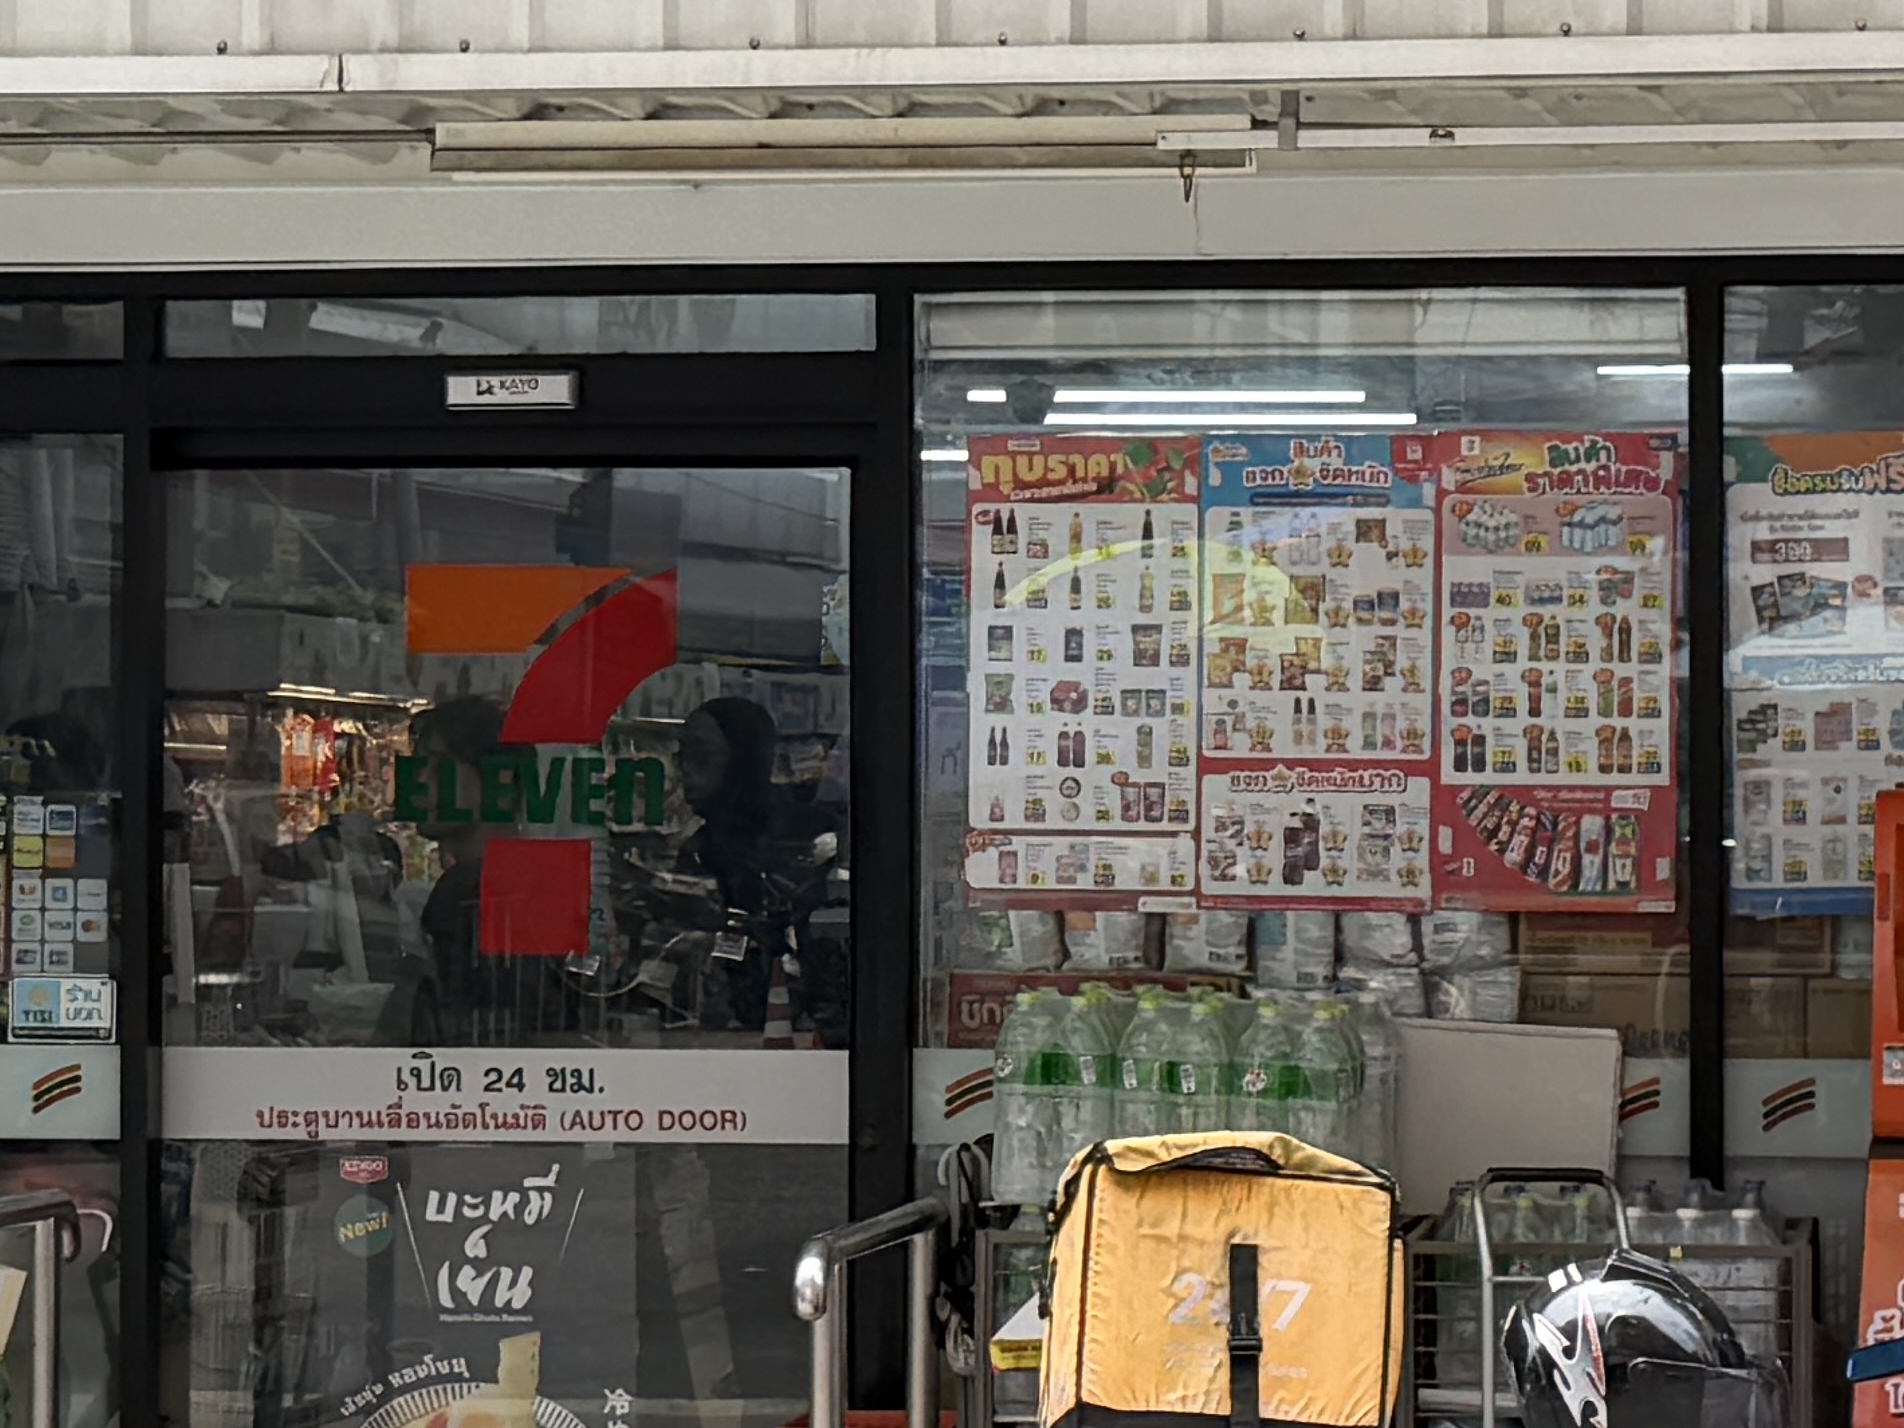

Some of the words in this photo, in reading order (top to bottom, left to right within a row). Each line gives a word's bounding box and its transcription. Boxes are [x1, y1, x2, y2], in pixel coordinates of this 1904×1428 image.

[393, 754, 666, 828] ELEVEN
[396, 1051, 463, 1094] เปิด
[483, 1068, 526, 1094] 24
[255, 1095, 548, 1139] ประตูบานเลื่อนอัตโนมัติ
[559, 1109, 645, 1133] (AUTO
[657, 1109, 748, 1134] DOOR)
[425, 1163, 560, 1226] บะหมี่
